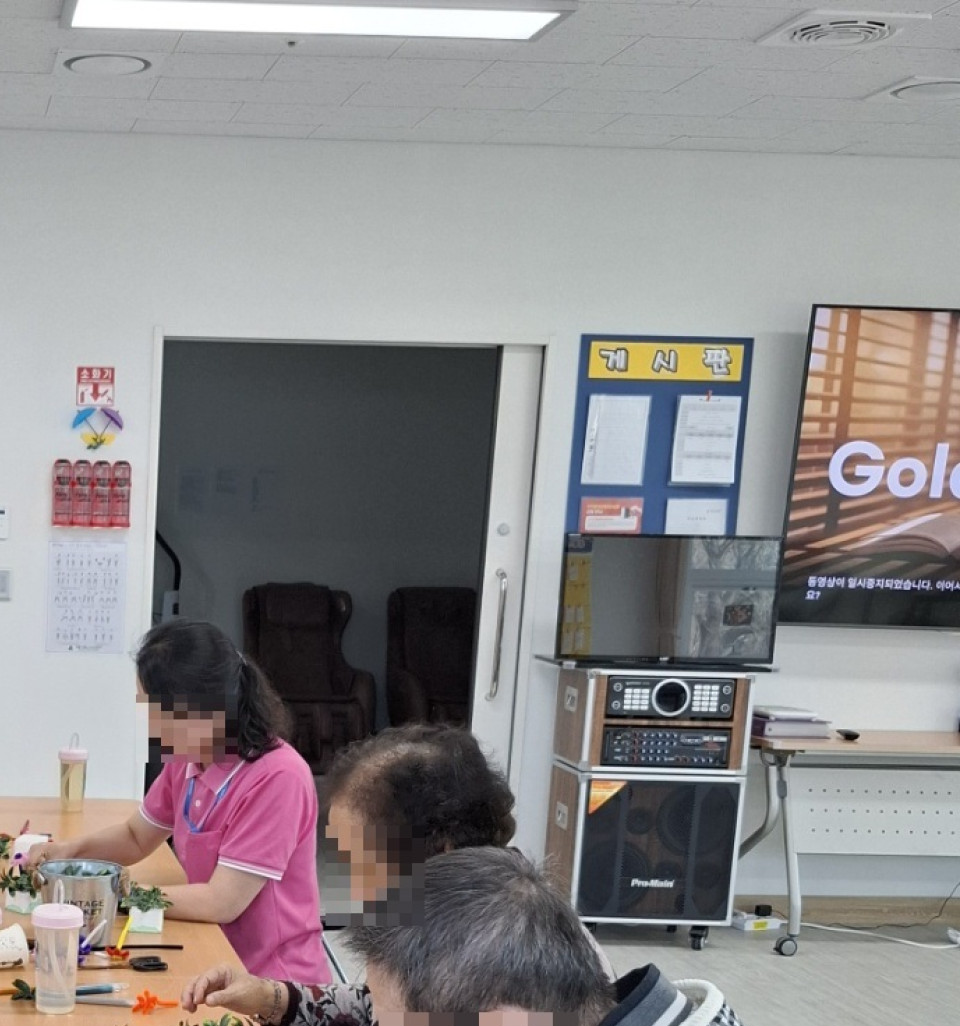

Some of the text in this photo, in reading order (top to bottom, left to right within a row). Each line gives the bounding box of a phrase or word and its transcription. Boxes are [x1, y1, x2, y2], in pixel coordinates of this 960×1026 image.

[80, 368, 112, 379] 소화기
[828, 441, 960, 499] Gol
[807, 576, 845, 588] 동영상이
[847, 577, 933, 590] 일시중지되었습니다.
[805, 590, 821, 600] 요?
